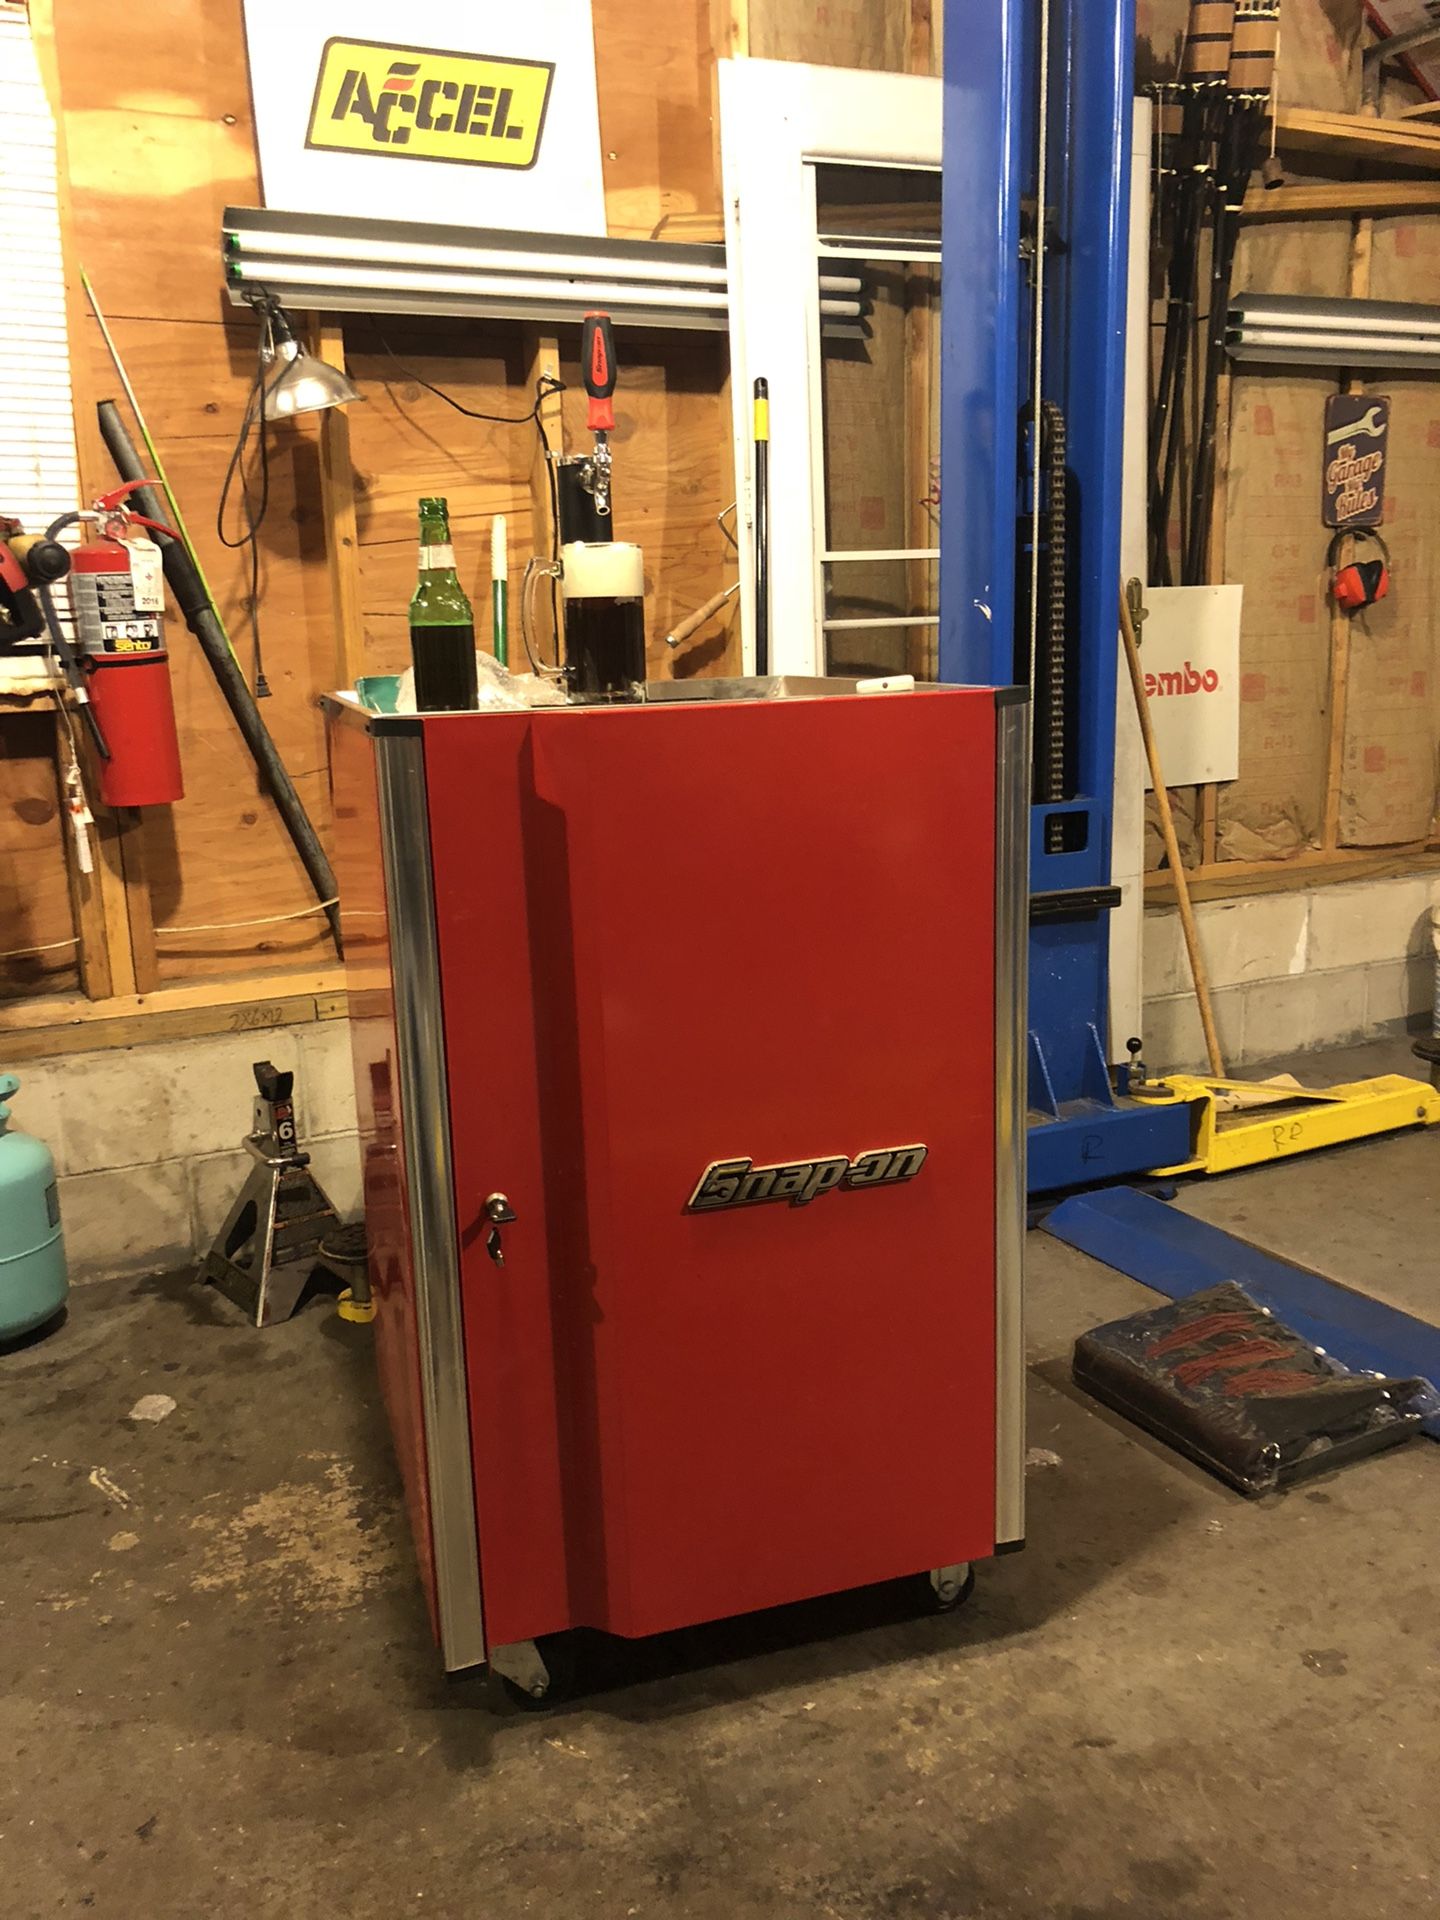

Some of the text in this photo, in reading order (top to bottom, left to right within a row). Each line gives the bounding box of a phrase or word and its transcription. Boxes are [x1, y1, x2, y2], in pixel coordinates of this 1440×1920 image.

[331, 69, 524, 144] ACCEL
[1326, 450, 1382, 494] Garage
[1335, 487, 1379, 521] Rules
[279, 1121, 293, 1140] 6
